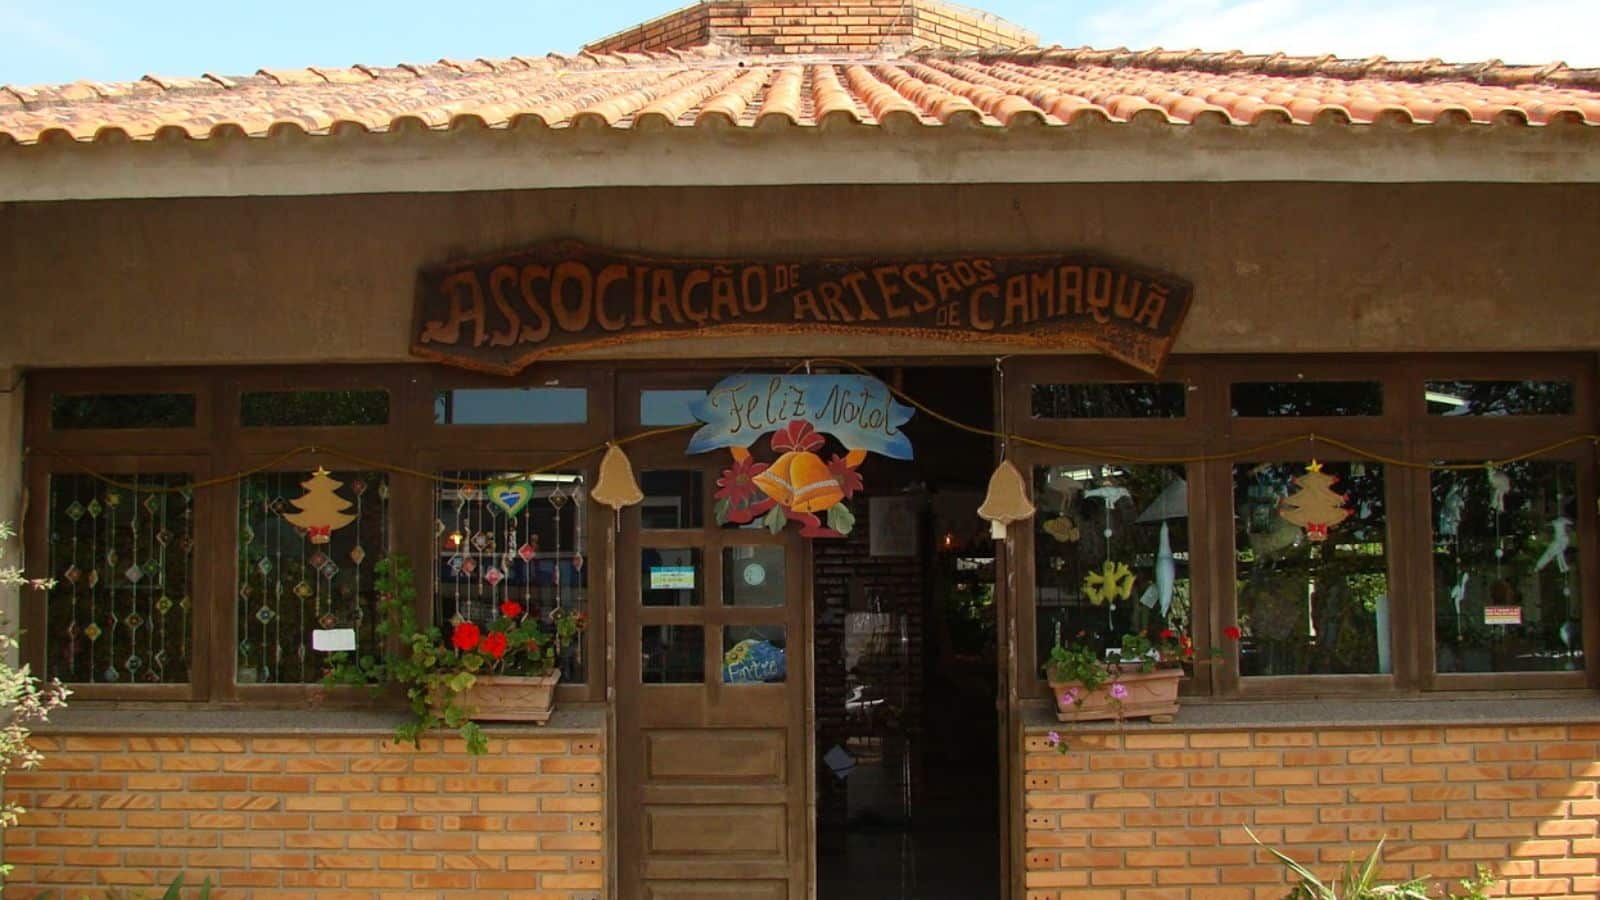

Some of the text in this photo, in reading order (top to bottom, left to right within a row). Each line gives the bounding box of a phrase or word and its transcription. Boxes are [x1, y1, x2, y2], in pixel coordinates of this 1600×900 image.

[420, 258, 1170, 347] ASSOCIAÇÃO DE ARTESÃOS DE CAMAQUÃ
[711, 375, 900, 436] Feliz Natal
